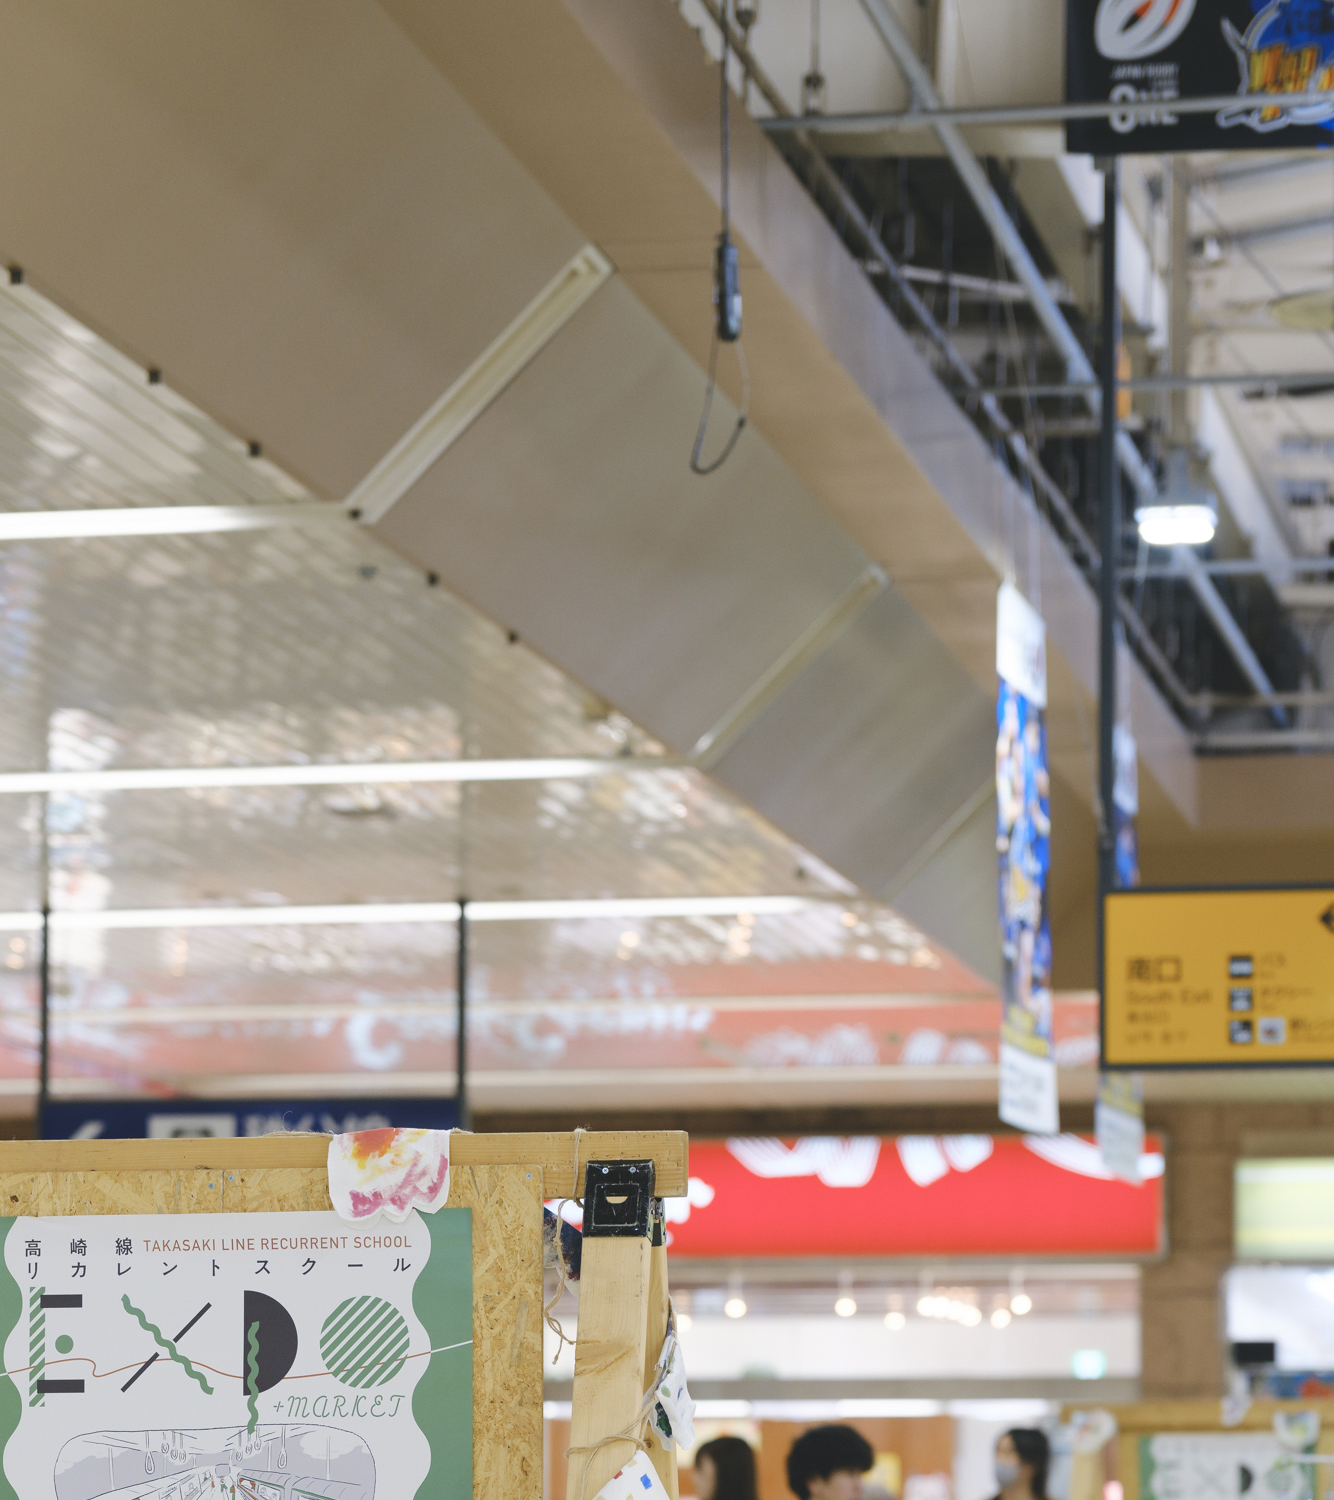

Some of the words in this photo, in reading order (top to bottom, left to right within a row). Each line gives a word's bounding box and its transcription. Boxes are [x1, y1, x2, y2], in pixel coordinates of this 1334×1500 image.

[24, 1238, 133, 1257] 高崎線
[143, 1238, 216, 1253] TAKASAKI
[221, 1238, 255, 1251] LINE
[261, 1236, 348, 1251] RECURRENT
[352, 1235, 412, 1249] SCHOOL
[26, 1257, 411, 1279] リカレントスクール
